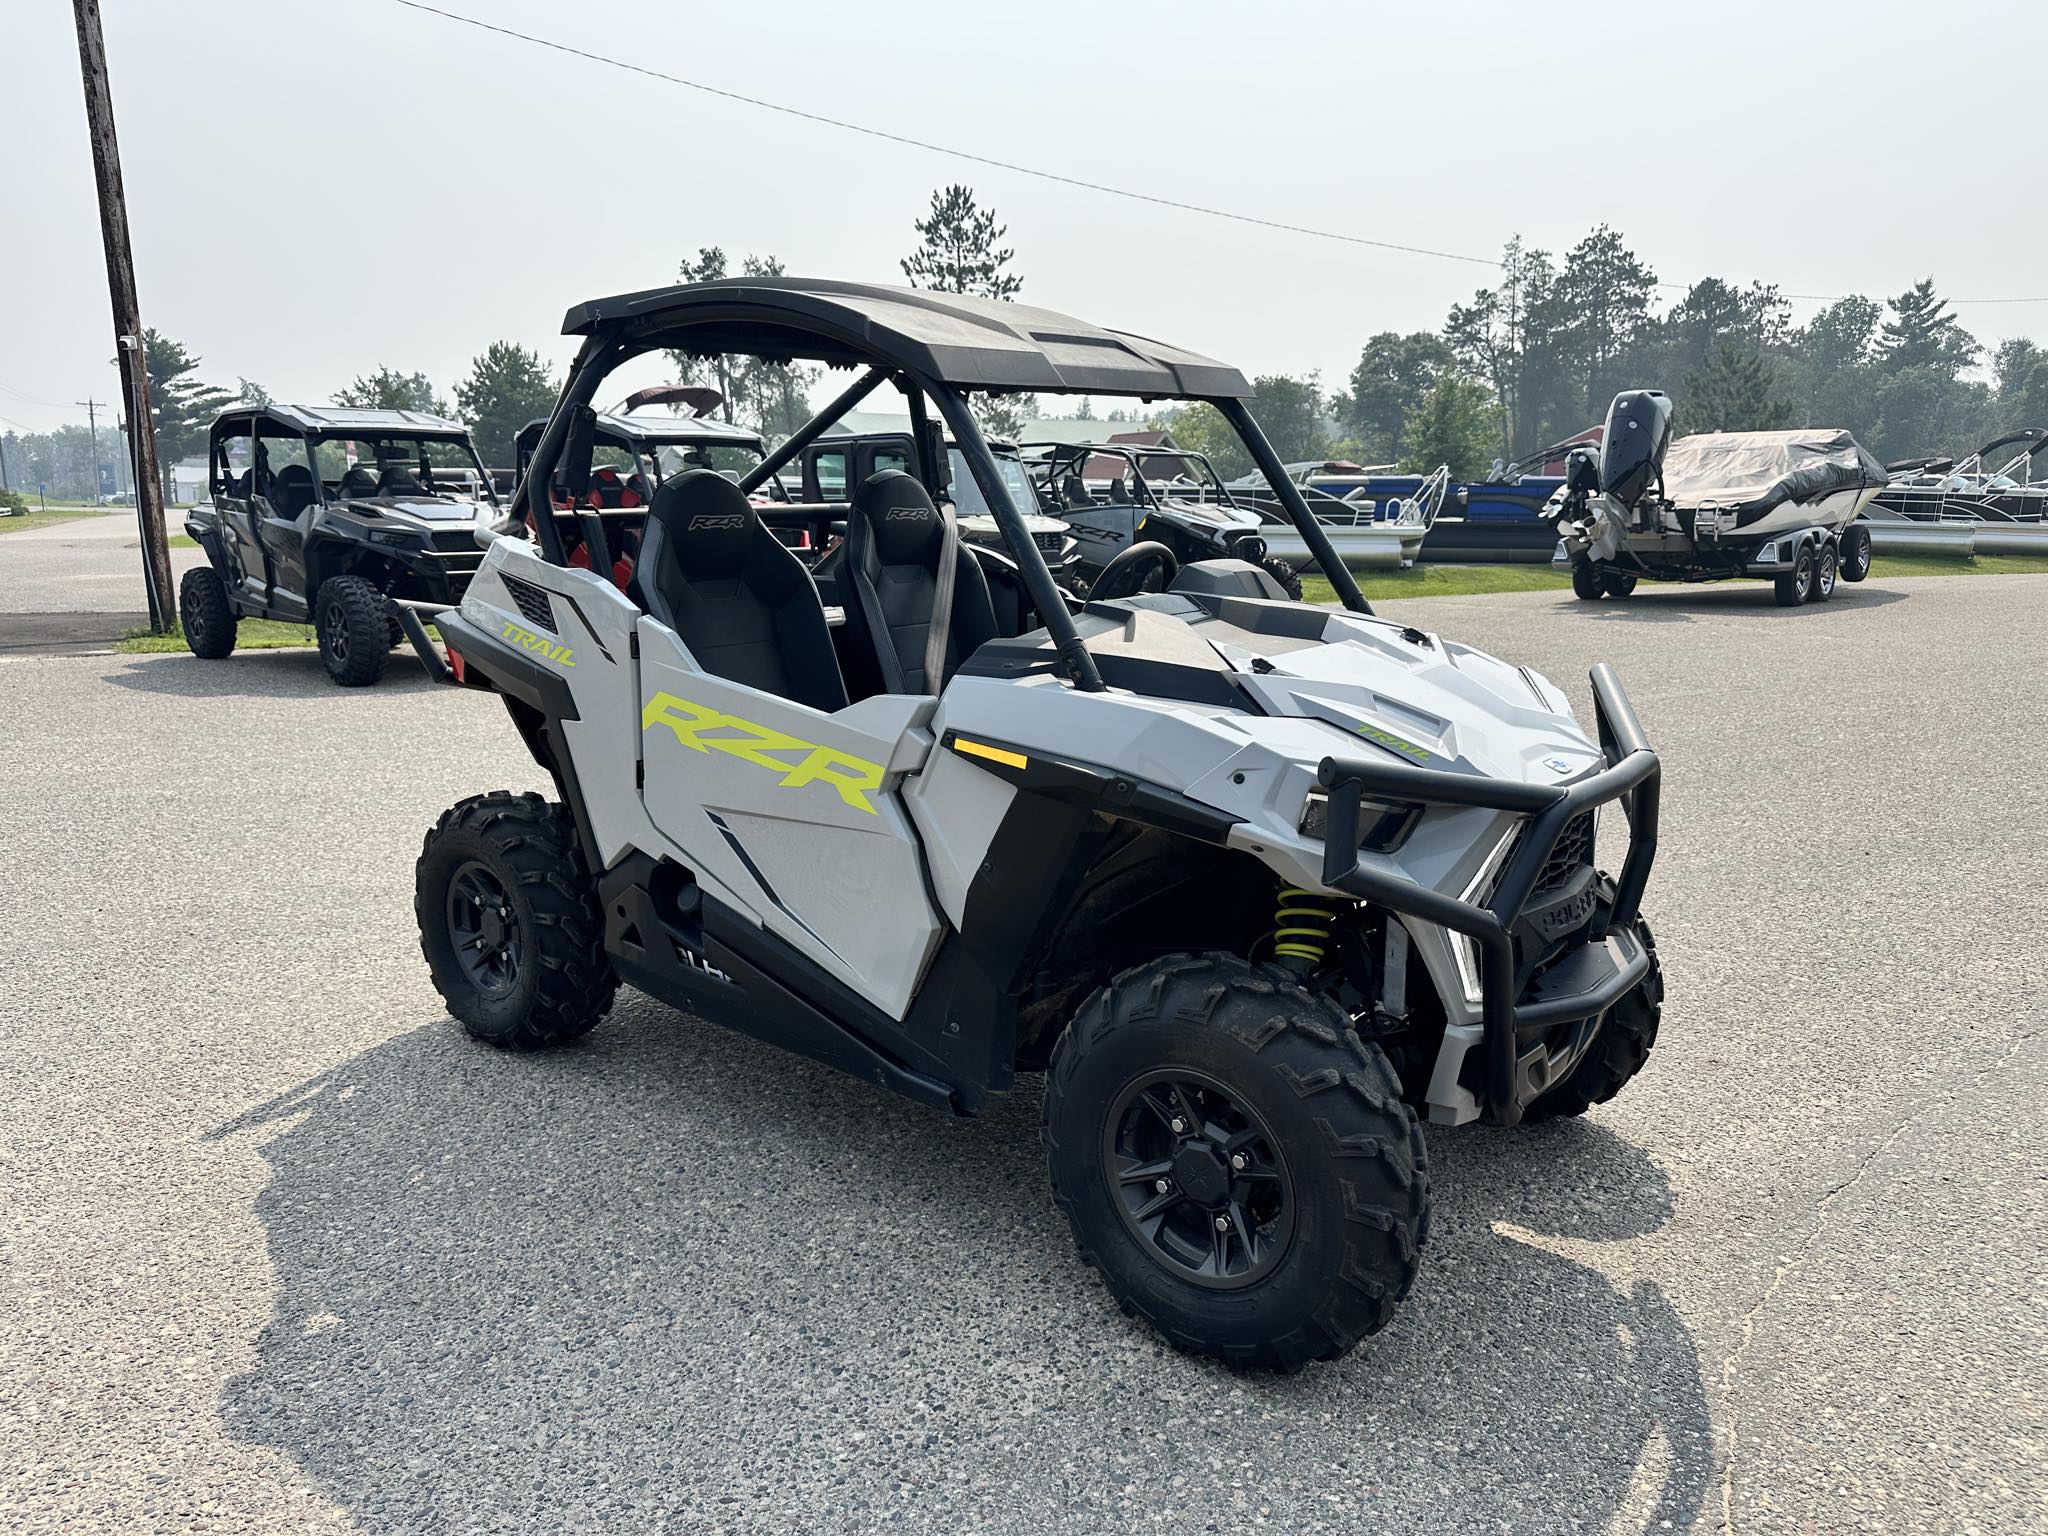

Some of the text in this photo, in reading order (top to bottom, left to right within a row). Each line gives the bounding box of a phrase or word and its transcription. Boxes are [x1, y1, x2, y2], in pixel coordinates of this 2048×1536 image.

[688, 514, 745, 532] RZR
[886, 507, 930, 521] RZR
[1069, 522, 1125, 543] RZR
[502, 622, 577, 667] TRAIL
[642, 691, 886, 817] RZR
[1357, 726, 1431, 761] TRAIL
